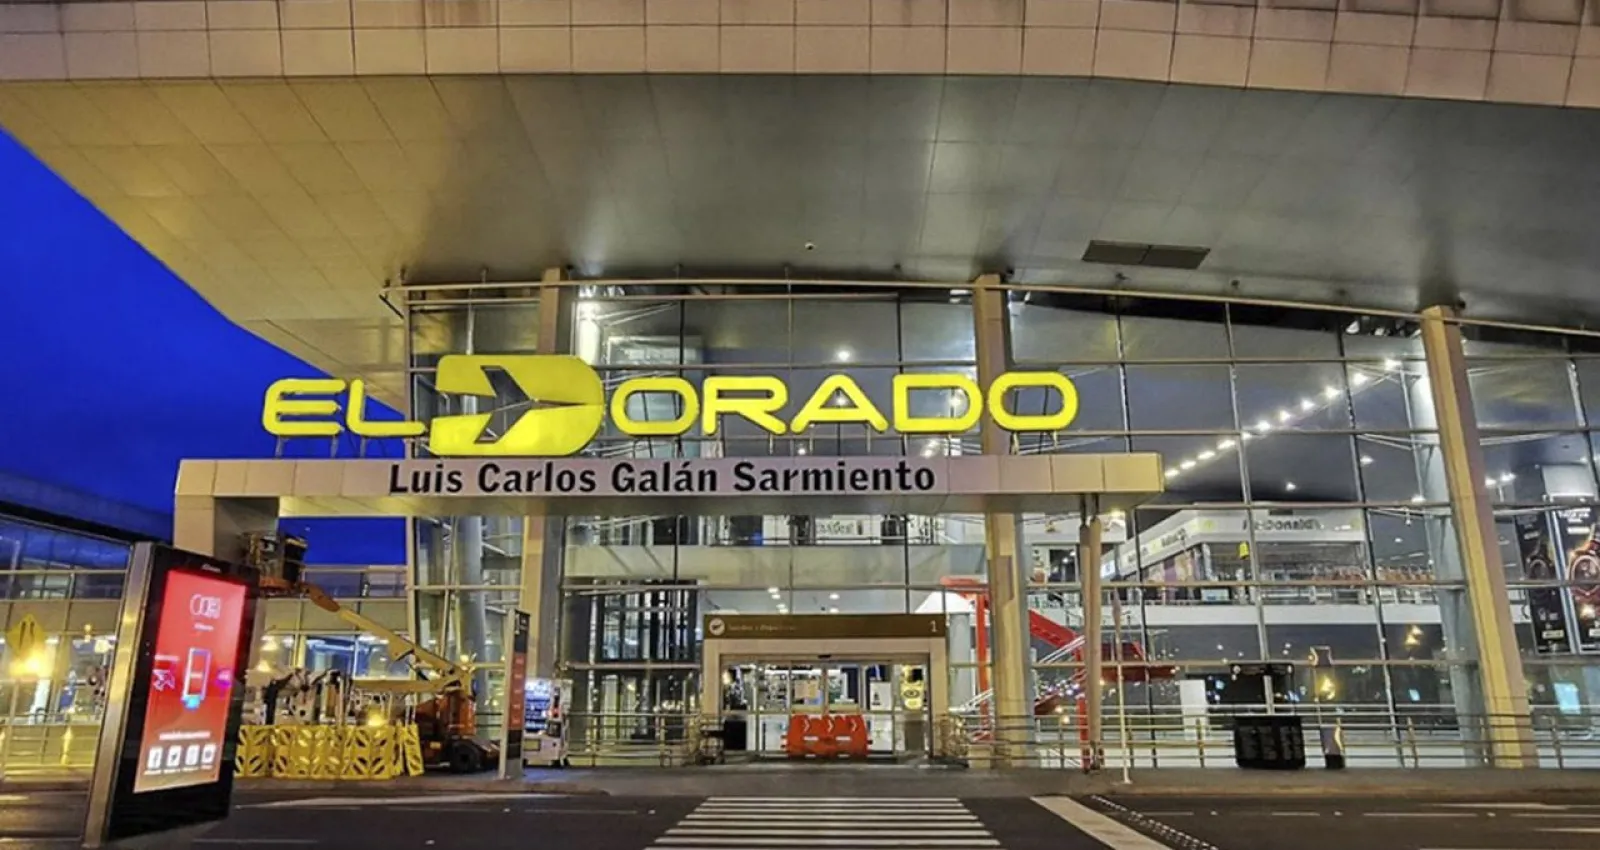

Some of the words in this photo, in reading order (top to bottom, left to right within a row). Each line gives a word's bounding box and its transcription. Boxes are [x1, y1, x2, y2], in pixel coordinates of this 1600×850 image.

[262, 378, 427, 437] EL
[389, 463, 463, 494] Luis
[478, 462, 596, 493] Carlos
[611, 461, 717, 493] Galán
[734, 461, 935, 492] Sarmiento
[930, 620, 938, 632] 1
